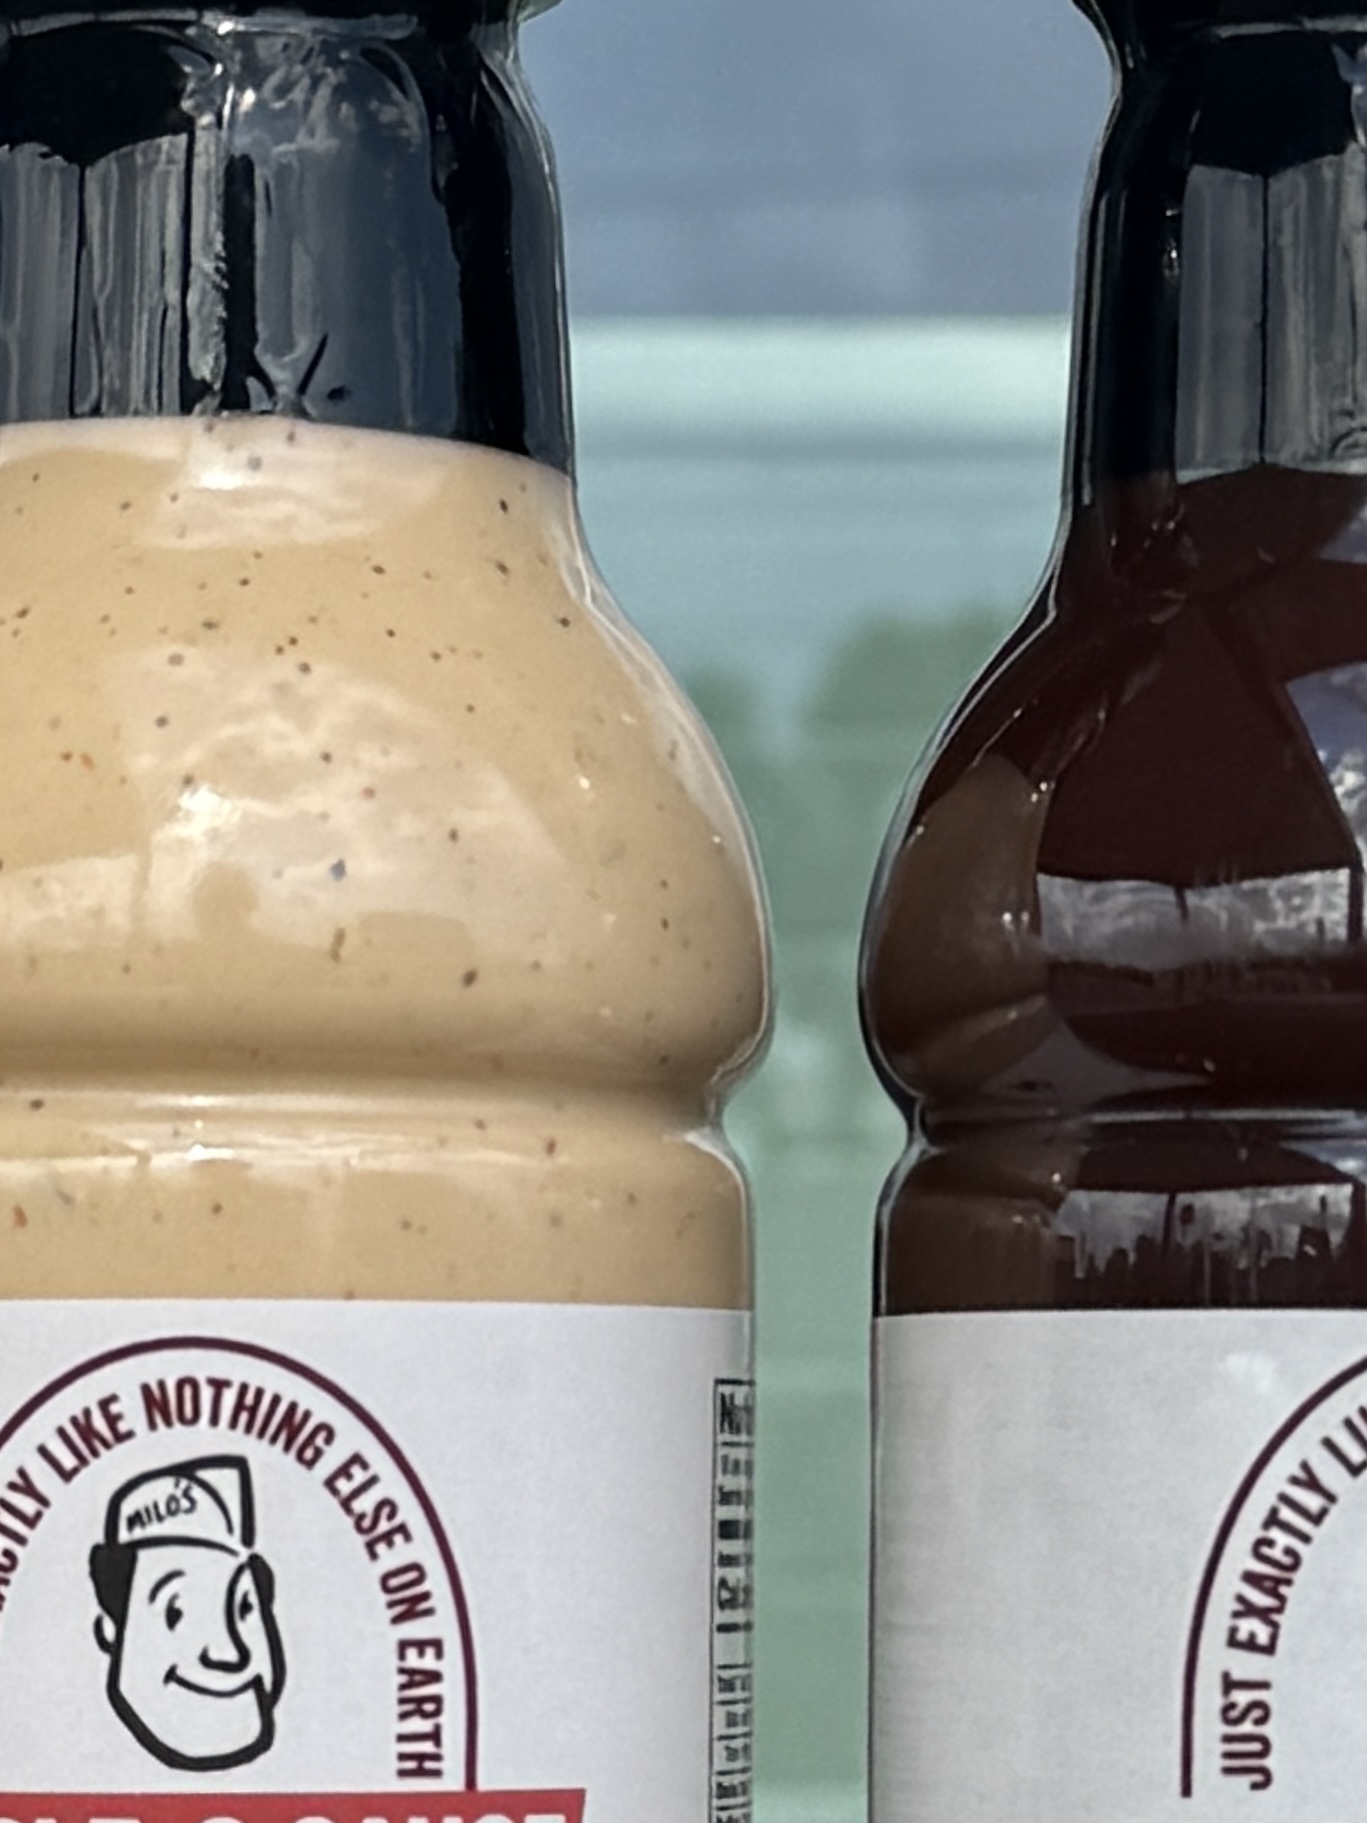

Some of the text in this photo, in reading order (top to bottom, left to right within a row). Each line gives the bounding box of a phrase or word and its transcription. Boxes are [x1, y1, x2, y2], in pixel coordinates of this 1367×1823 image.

[37, 1393, 136, 1484] LIKE
[141, 1376, 336, 1471] NOTHING
[127, 1477, 197, 1533] MILO'S
[323, 1452, 413, 1561] ELSE
[380, 1562, 436, 1625] ON
[1227, 1460, 1338, 1657] EXACTLY
[395, 1638, 443, 1779] EARTH
[1220, 1671, 1272, 1791] JUST
